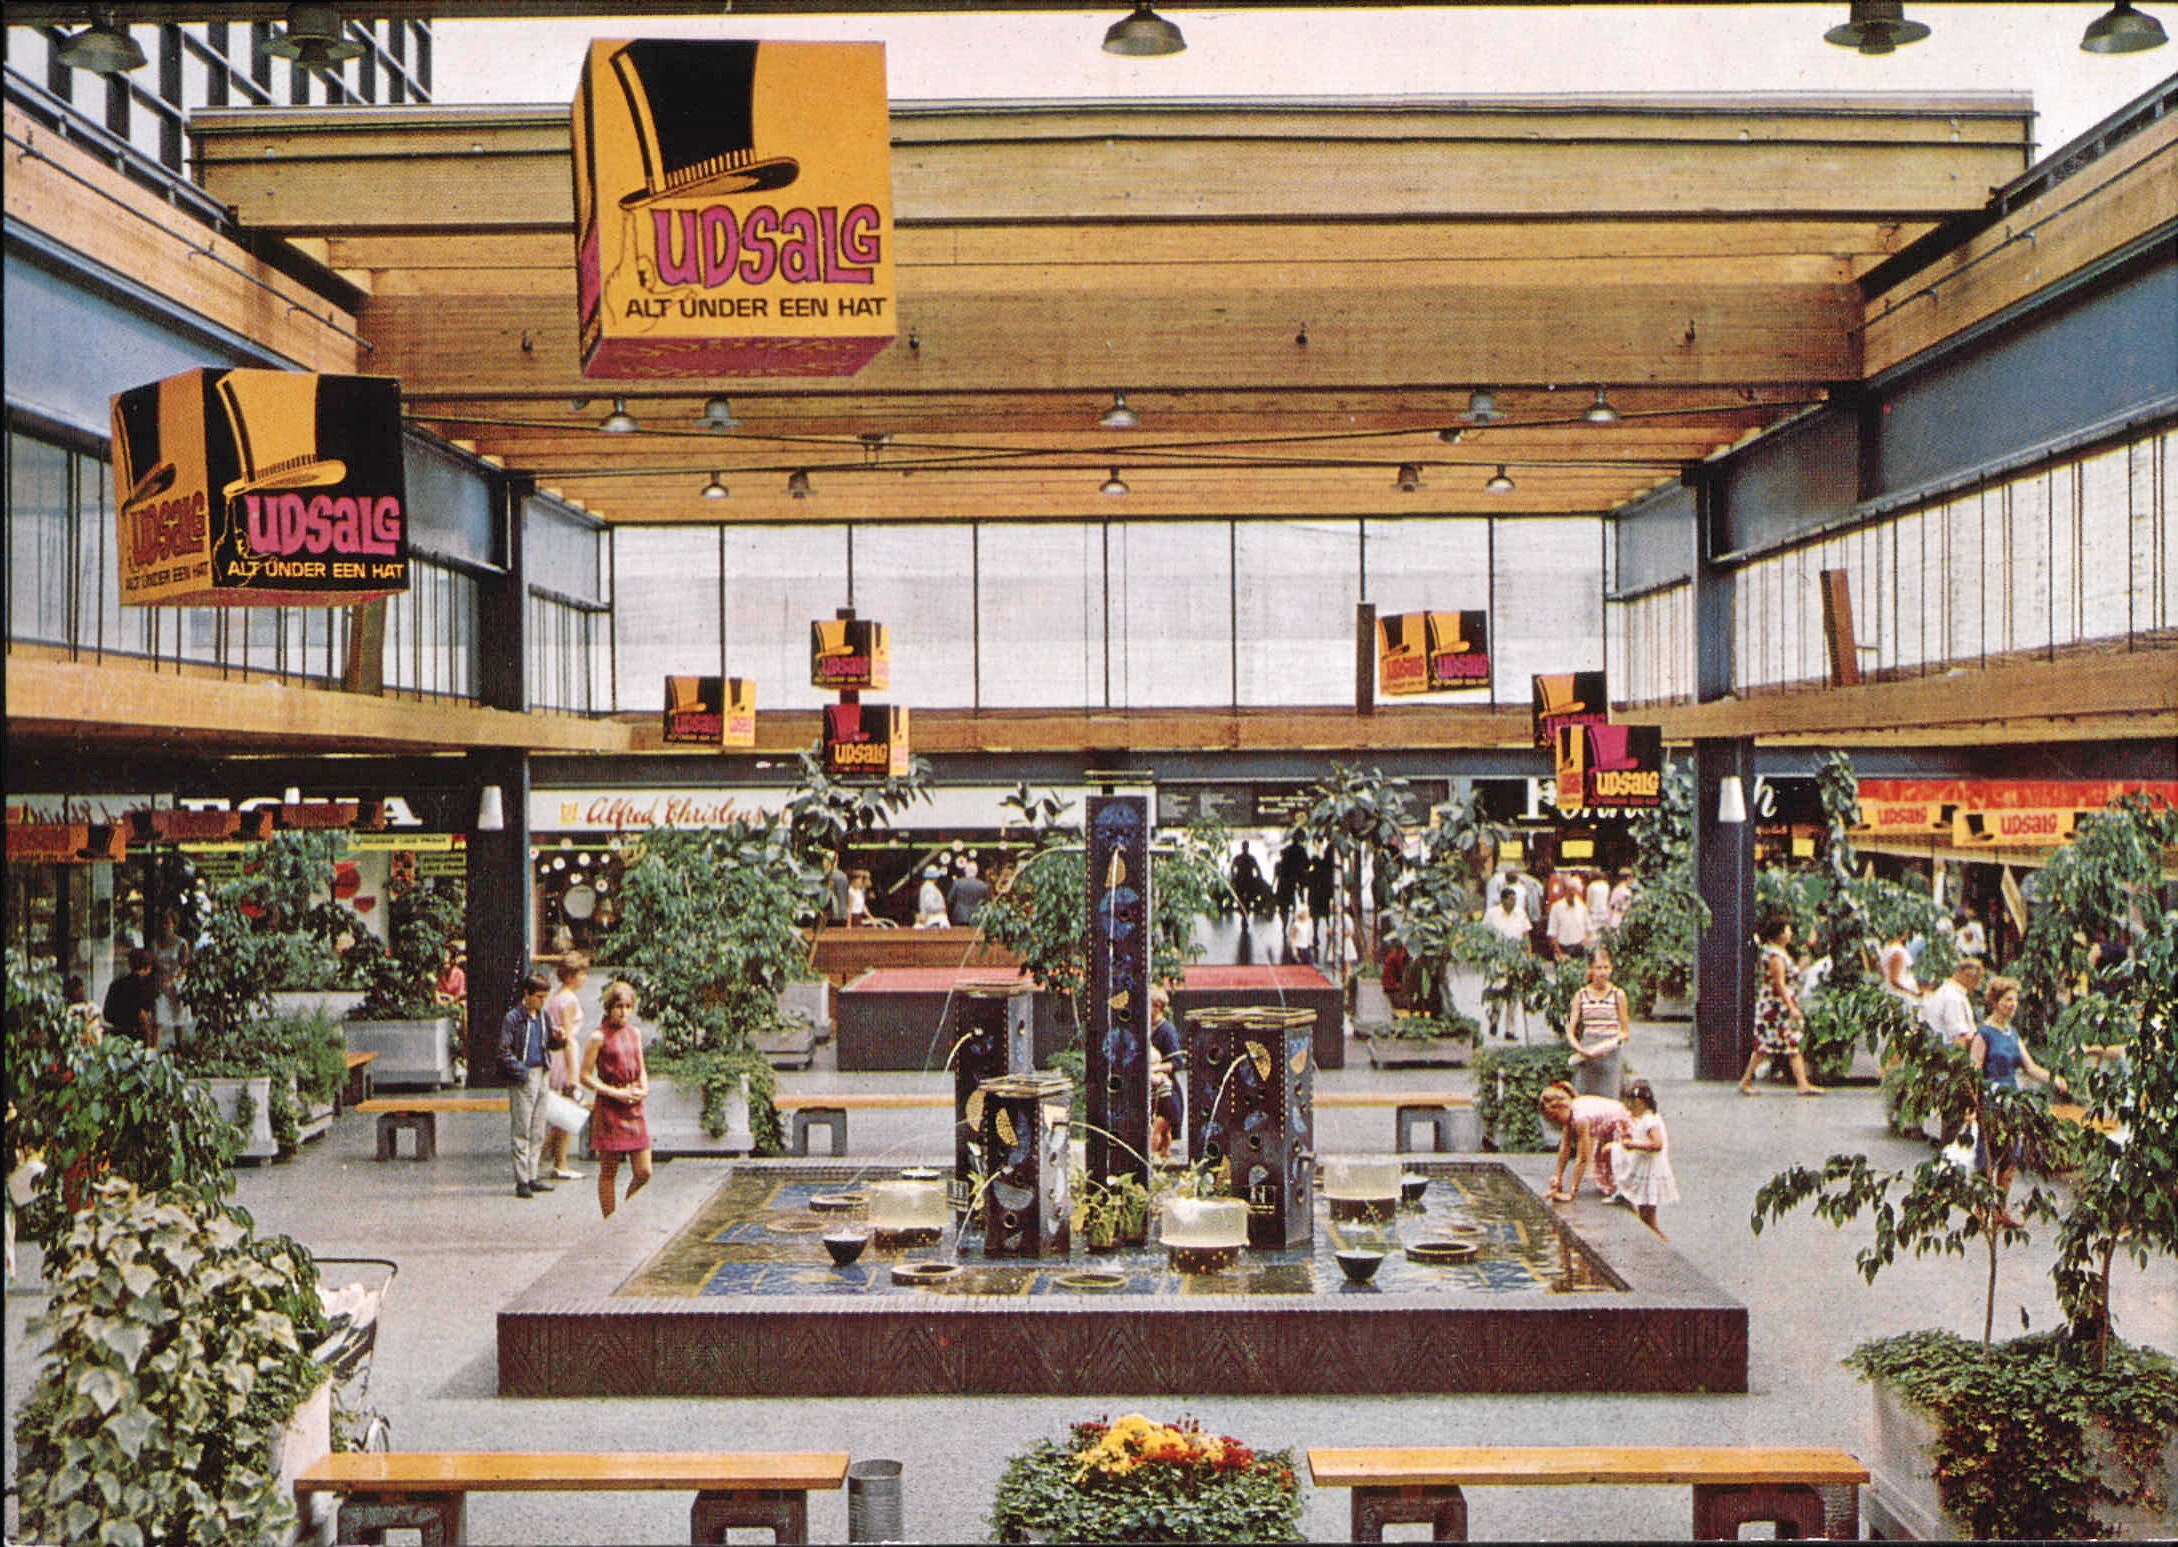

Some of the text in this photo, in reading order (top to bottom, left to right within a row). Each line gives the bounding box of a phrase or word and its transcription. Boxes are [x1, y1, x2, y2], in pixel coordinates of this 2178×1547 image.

[626, 297, 887, 318] ALT UNDER EEN HAT
[227, 561, 405, 579] ALT UNDER EEN HAT
[586, 795, 788, 832] Alfred Christens
